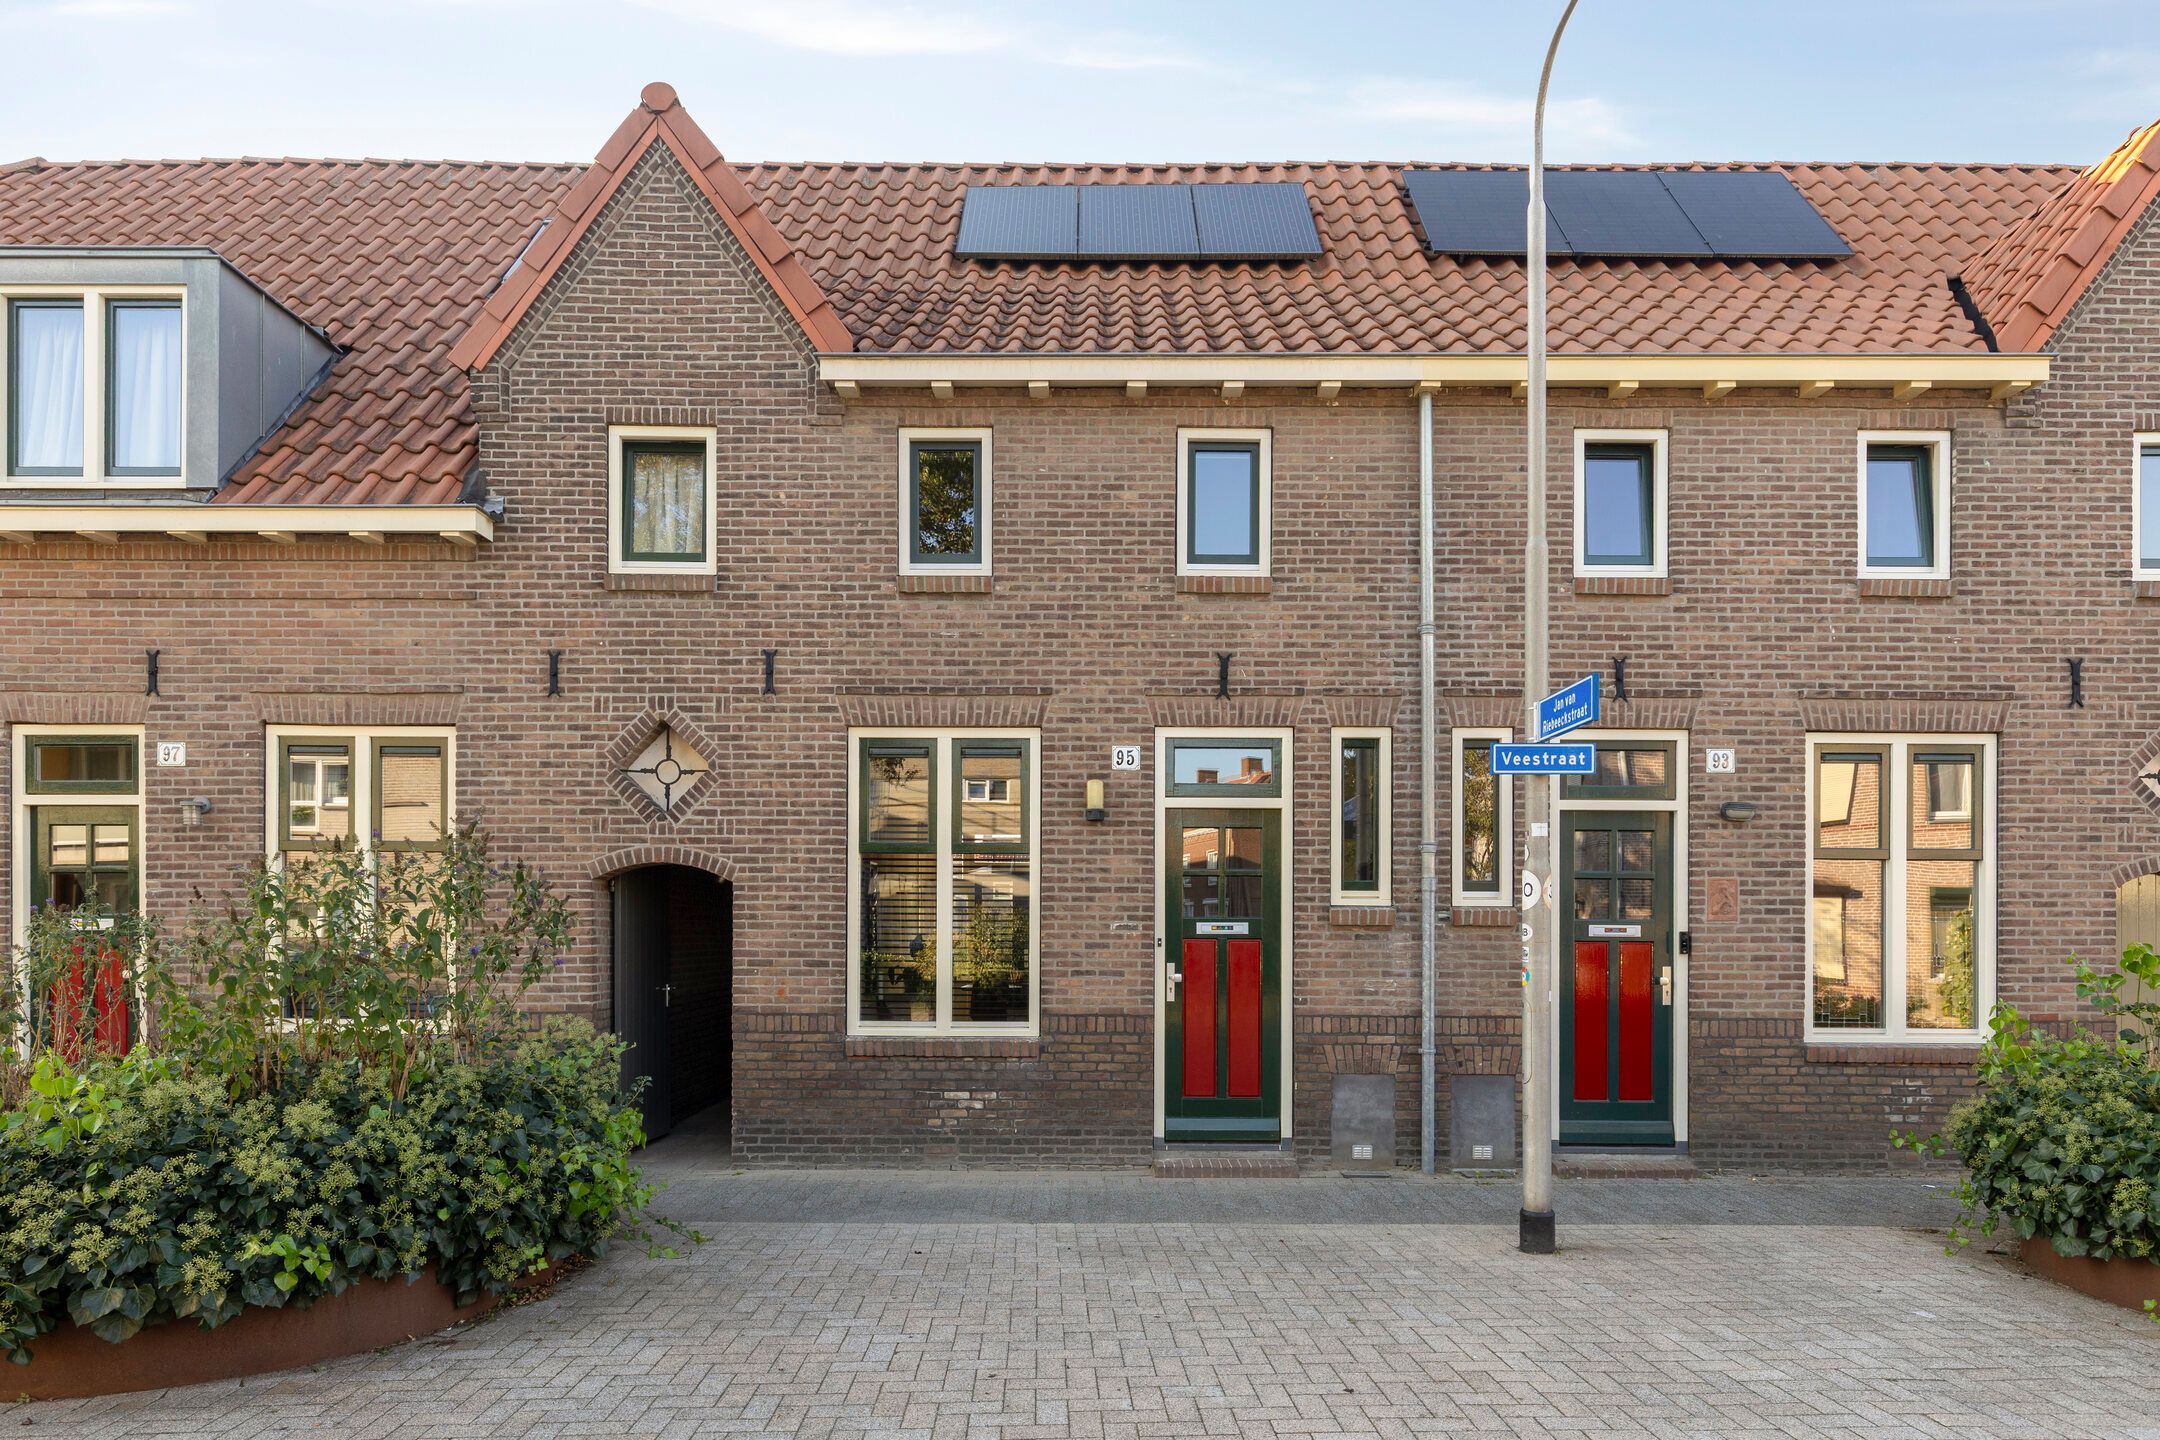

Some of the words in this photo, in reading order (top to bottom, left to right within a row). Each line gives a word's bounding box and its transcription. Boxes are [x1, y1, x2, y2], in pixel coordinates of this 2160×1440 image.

[1553, 698, 1564, 712] Jan
[1564, 693, 1576, 706] van
[1542, 702, 1588, 733] Riebeeckstraat
[163, 745, 180, 761] 97
[1116, 749, 1134, 765] 95
[1501, 751, 1586, 766] Veestraat
[1712, 752, 1729, 768] 93
